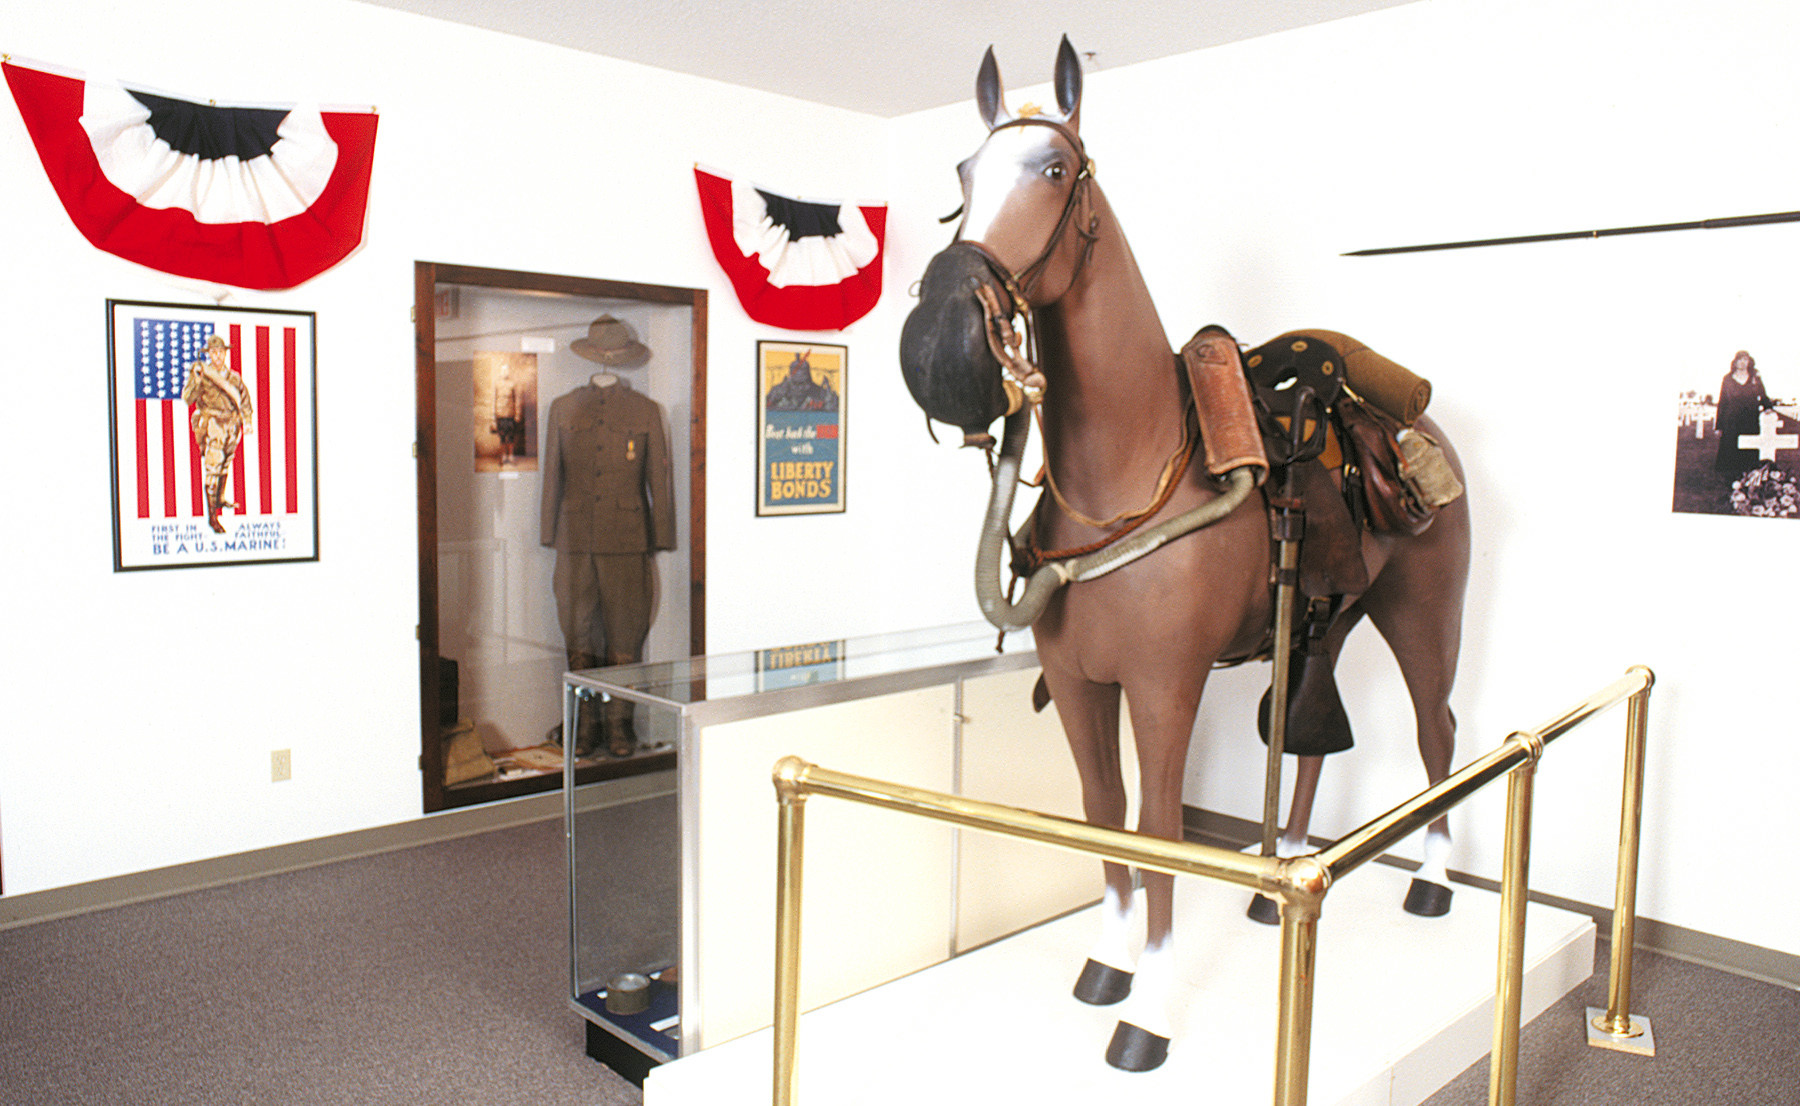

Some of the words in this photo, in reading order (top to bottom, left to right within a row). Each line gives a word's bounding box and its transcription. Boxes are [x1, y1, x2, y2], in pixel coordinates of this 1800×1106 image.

[791, 441, 814, 455] with
[771, 461, 834, 480] LIBERTY
[771, 480, 831, 500] BONDS
[151, 524, 179, 533] FIRST
[186, 524, 197, 532] IN
[239, 522, 281, 531] ALWAYS
[153, 543, 169, 555] BE
[176, 542, 189, 554] A
